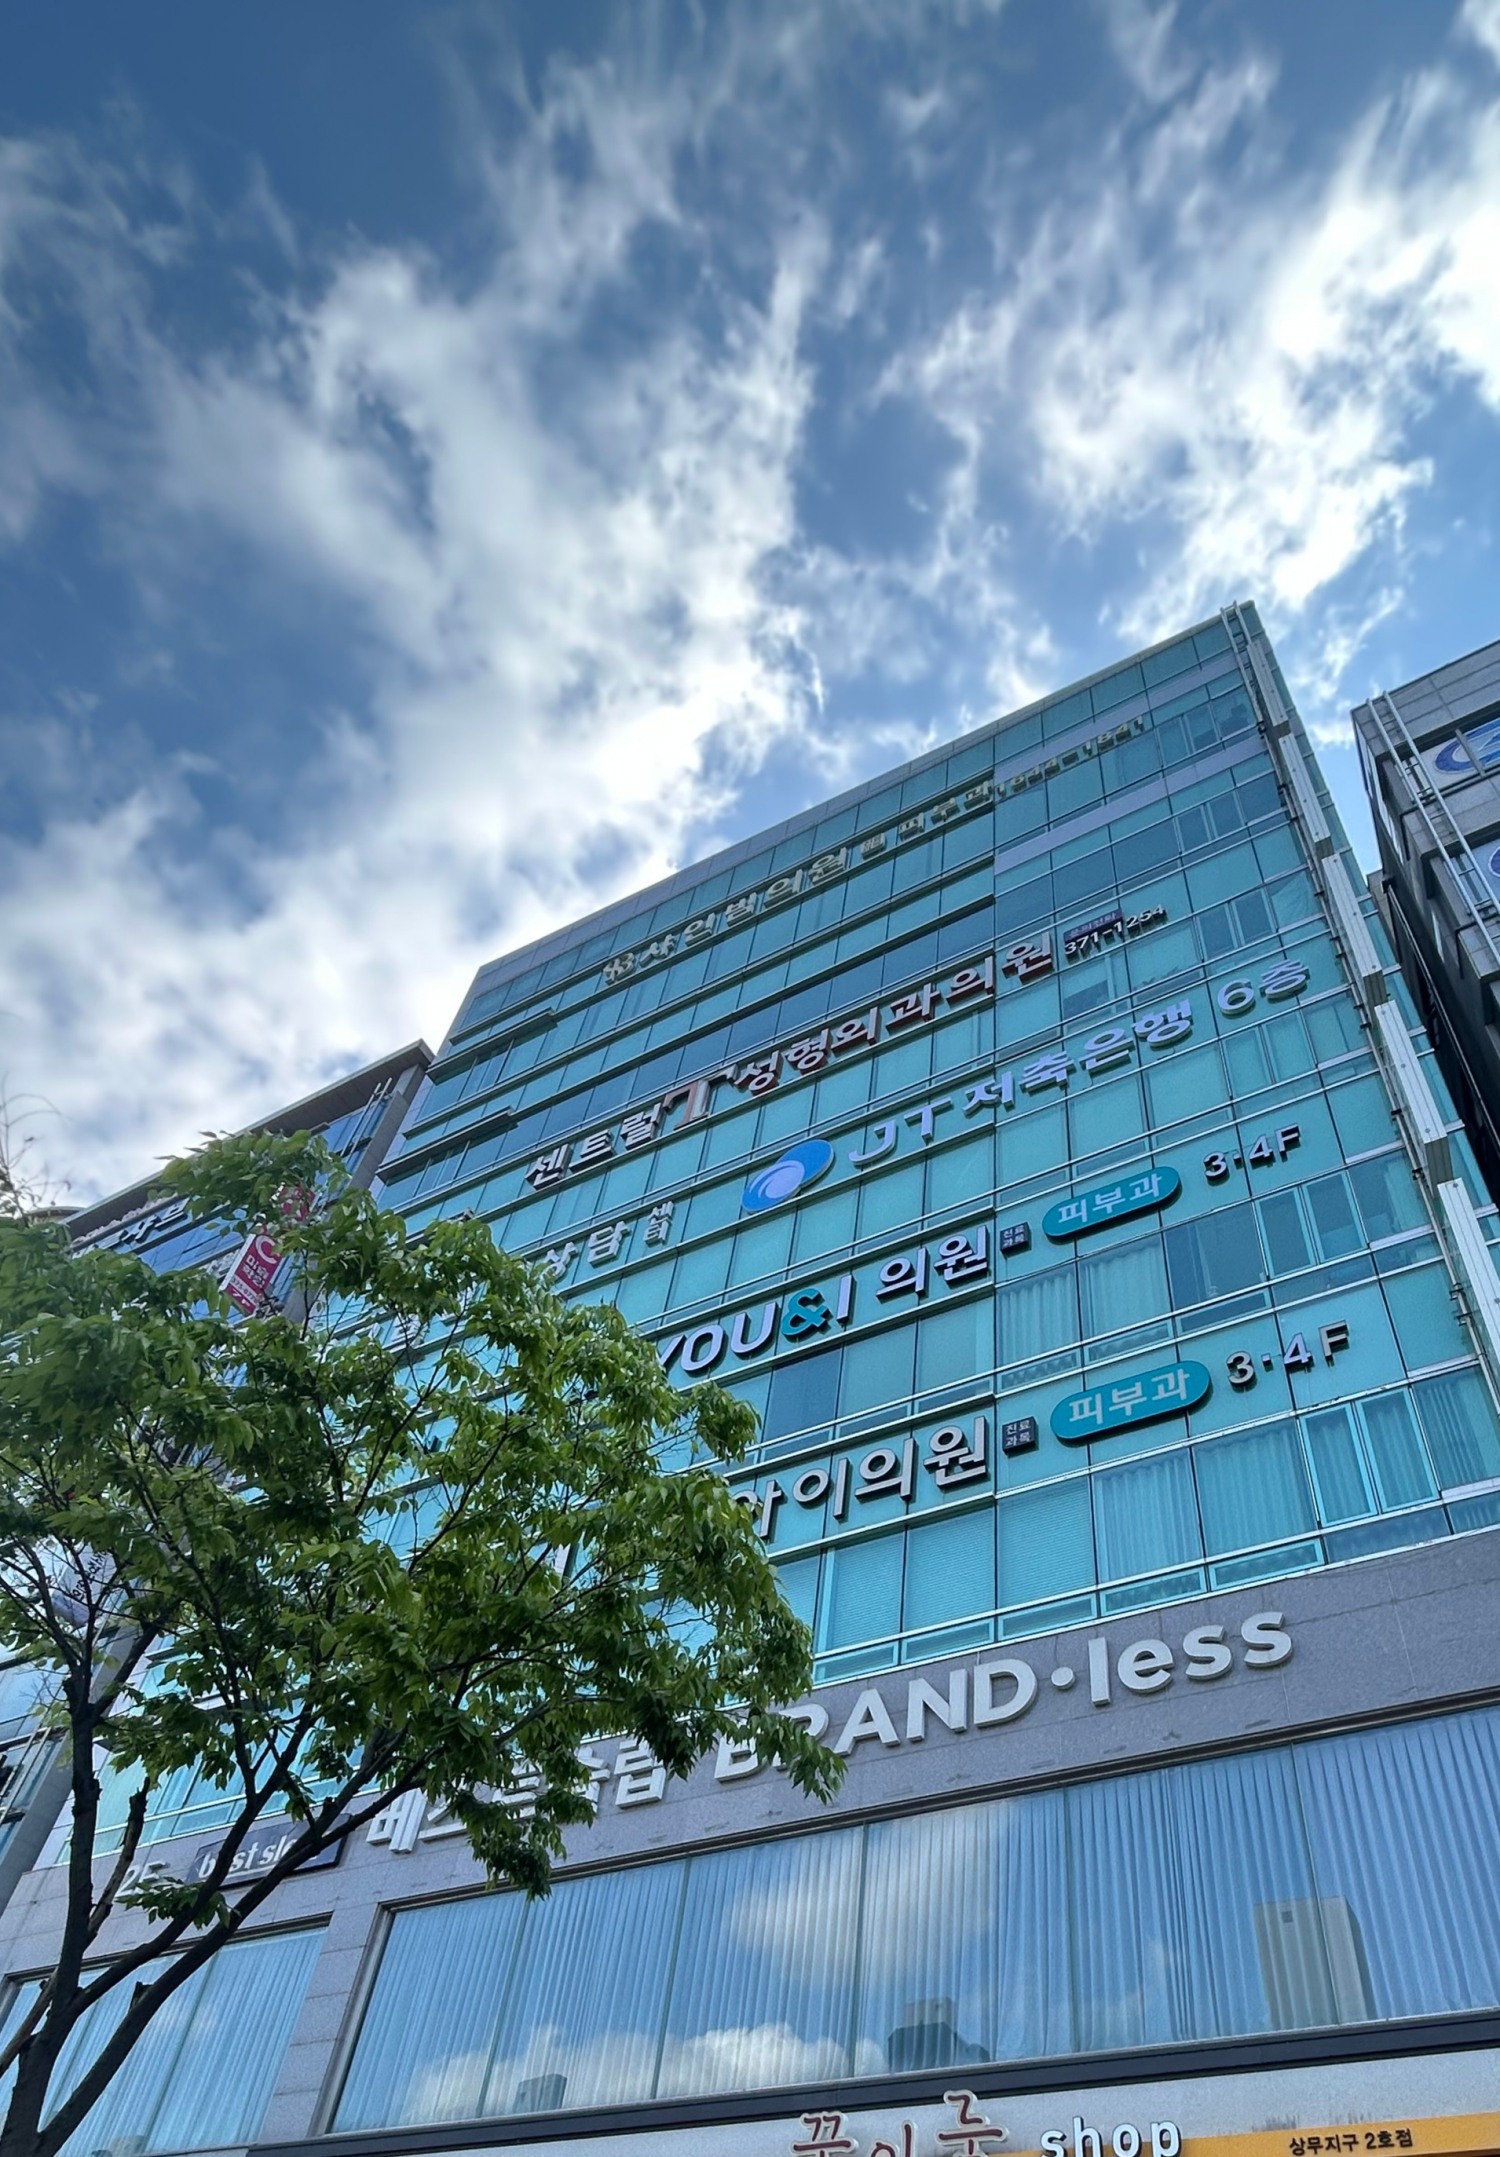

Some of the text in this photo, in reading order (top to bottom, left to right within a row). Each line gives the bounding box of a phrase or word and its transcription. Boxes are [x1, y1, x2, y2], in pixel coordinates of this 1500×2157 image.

[899, 781, 993, 837] 피부과
[1065, 904, 1166, 954] 371-1254
[1216, 957, 1309, 1017] 6층
[1057, 1172, 1163, 1223] 피부과
[876, 1225, 989, 1299] 의원
[1068, 1368, 1190, 1425] 피부과
[198, 1841, 259, 1879] bst
[1041, 2115, 1182, 2157] shop
[1289, 2128, 1414, 2157] 상무지구 2호점
